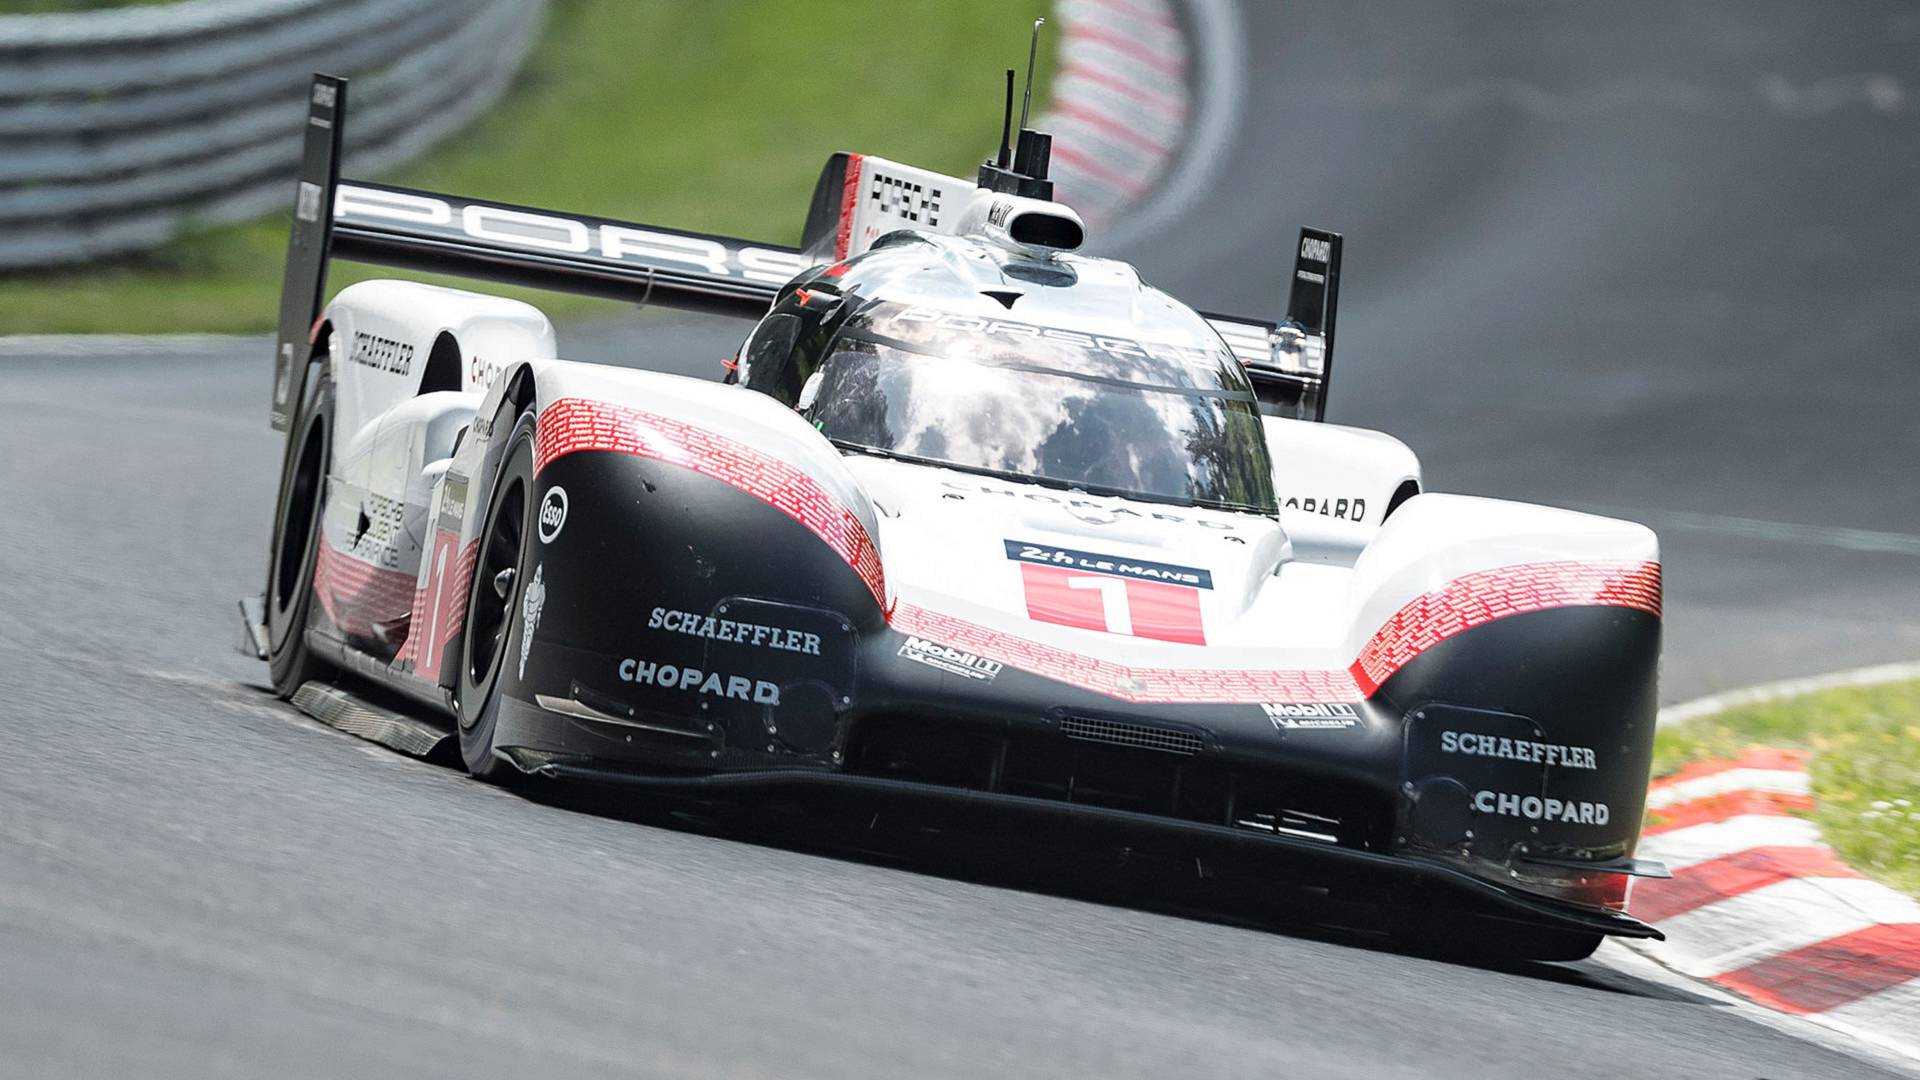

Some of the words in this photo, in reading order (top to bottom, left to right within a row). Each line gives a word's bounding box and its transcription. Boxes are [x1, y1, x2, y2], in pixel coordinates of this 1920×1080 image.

[871, 173, 943, 227] PORSCHE
[1079, 559, 1115, 571] LE
[1118, 565, 1199, 583] MANS
[1067, 576, 1136, 636] 1
[648, 606, 821, 655] SCHAEFFLER
[618, 658, 781, 705] CHOPARD
[1441, 731, 1597, 769] SCHAEFFLER
[1475, 790, 1609, 826] CHOPARD
